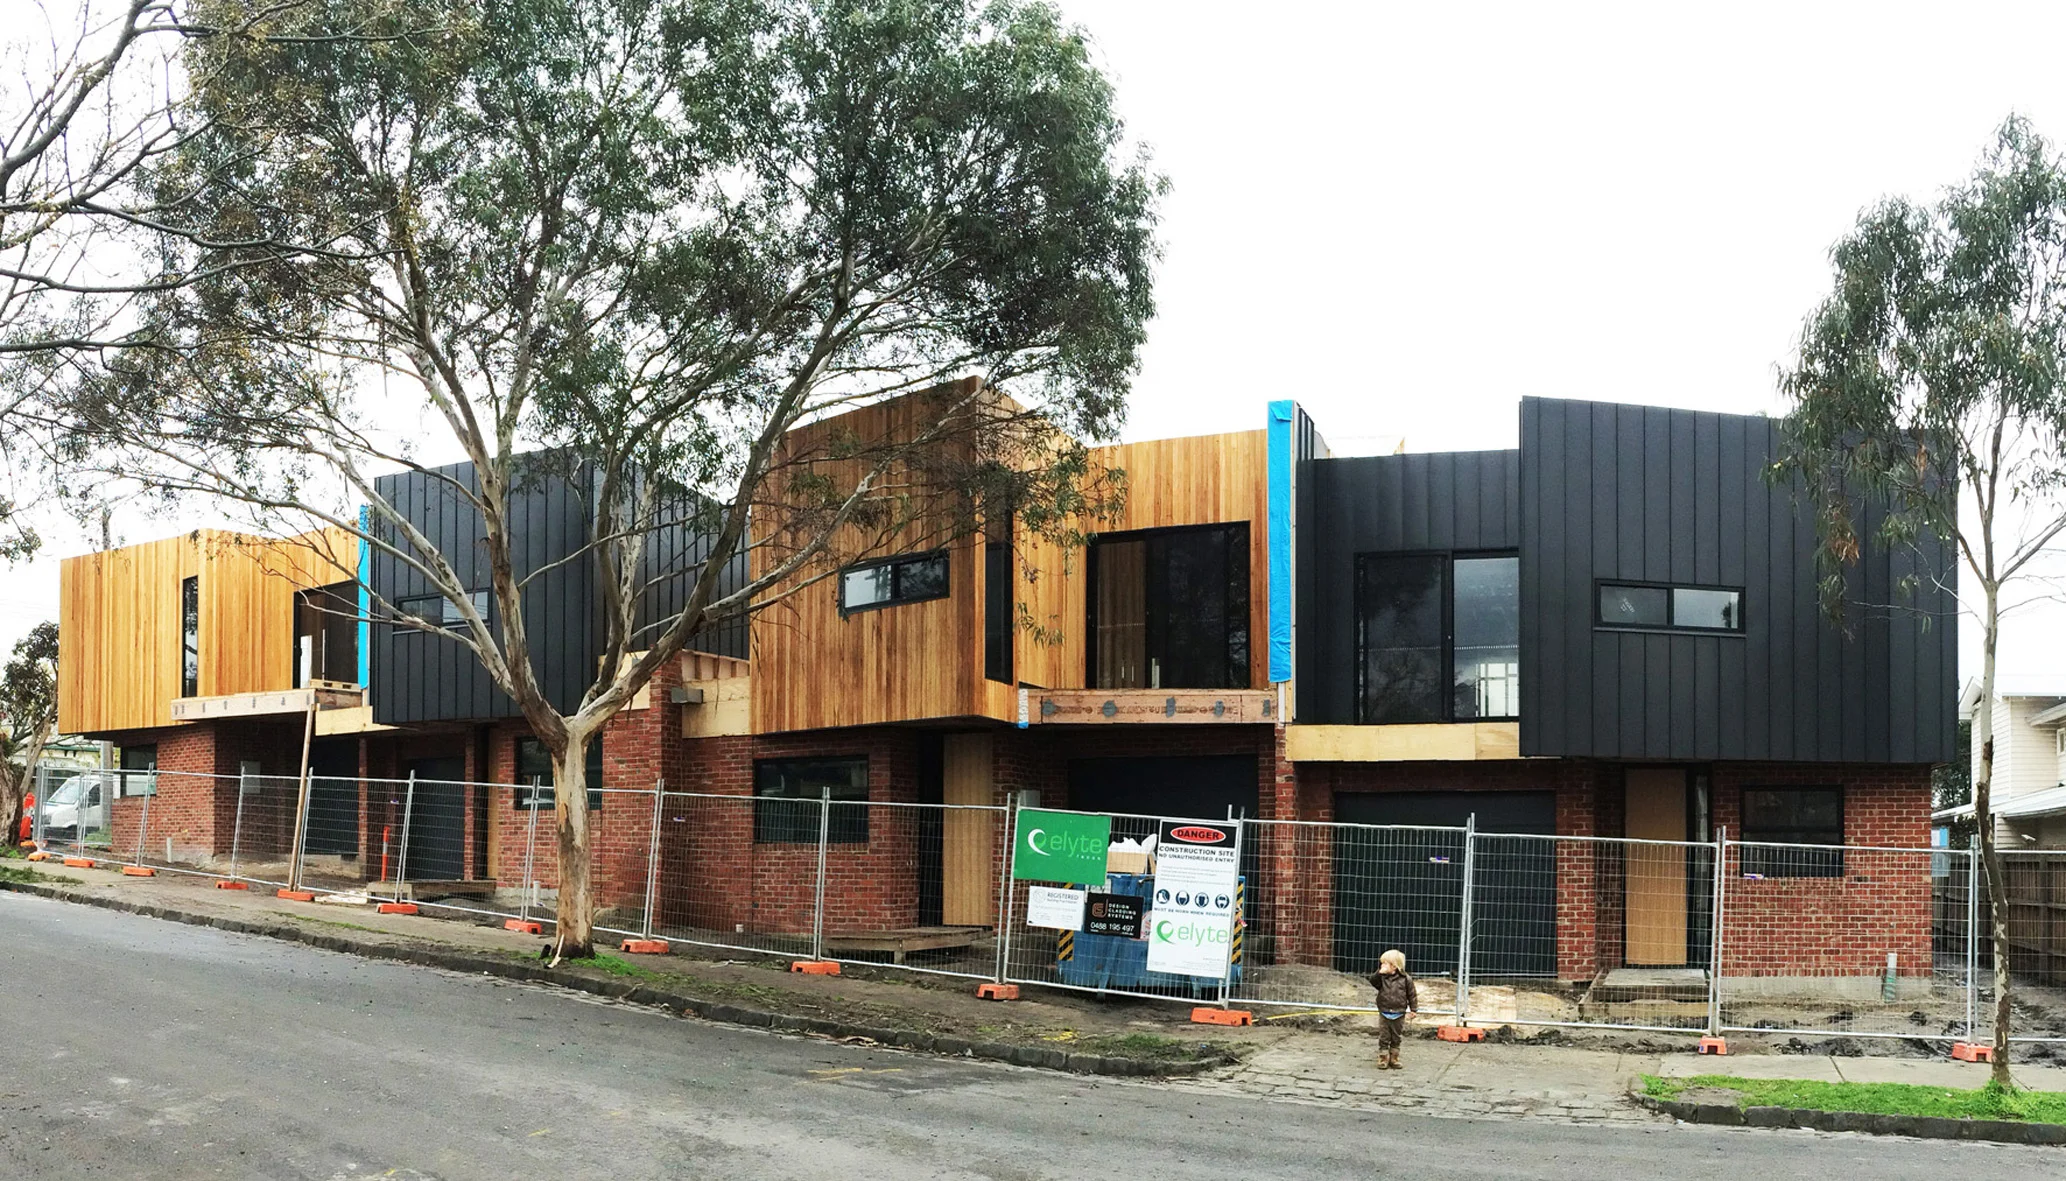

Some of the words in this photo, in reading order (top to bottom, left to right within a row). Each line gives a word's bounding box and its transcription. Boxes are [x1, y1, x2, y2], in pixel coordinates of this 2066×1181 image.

[1177, 830, 1219, 840] DANGER
[1159, 846, 1216, 856] CONSTRUCTION
[1168, 853, 1214, 862] UNAUTHORISED
[1047, 891, 1079, 901] REGISTERED
